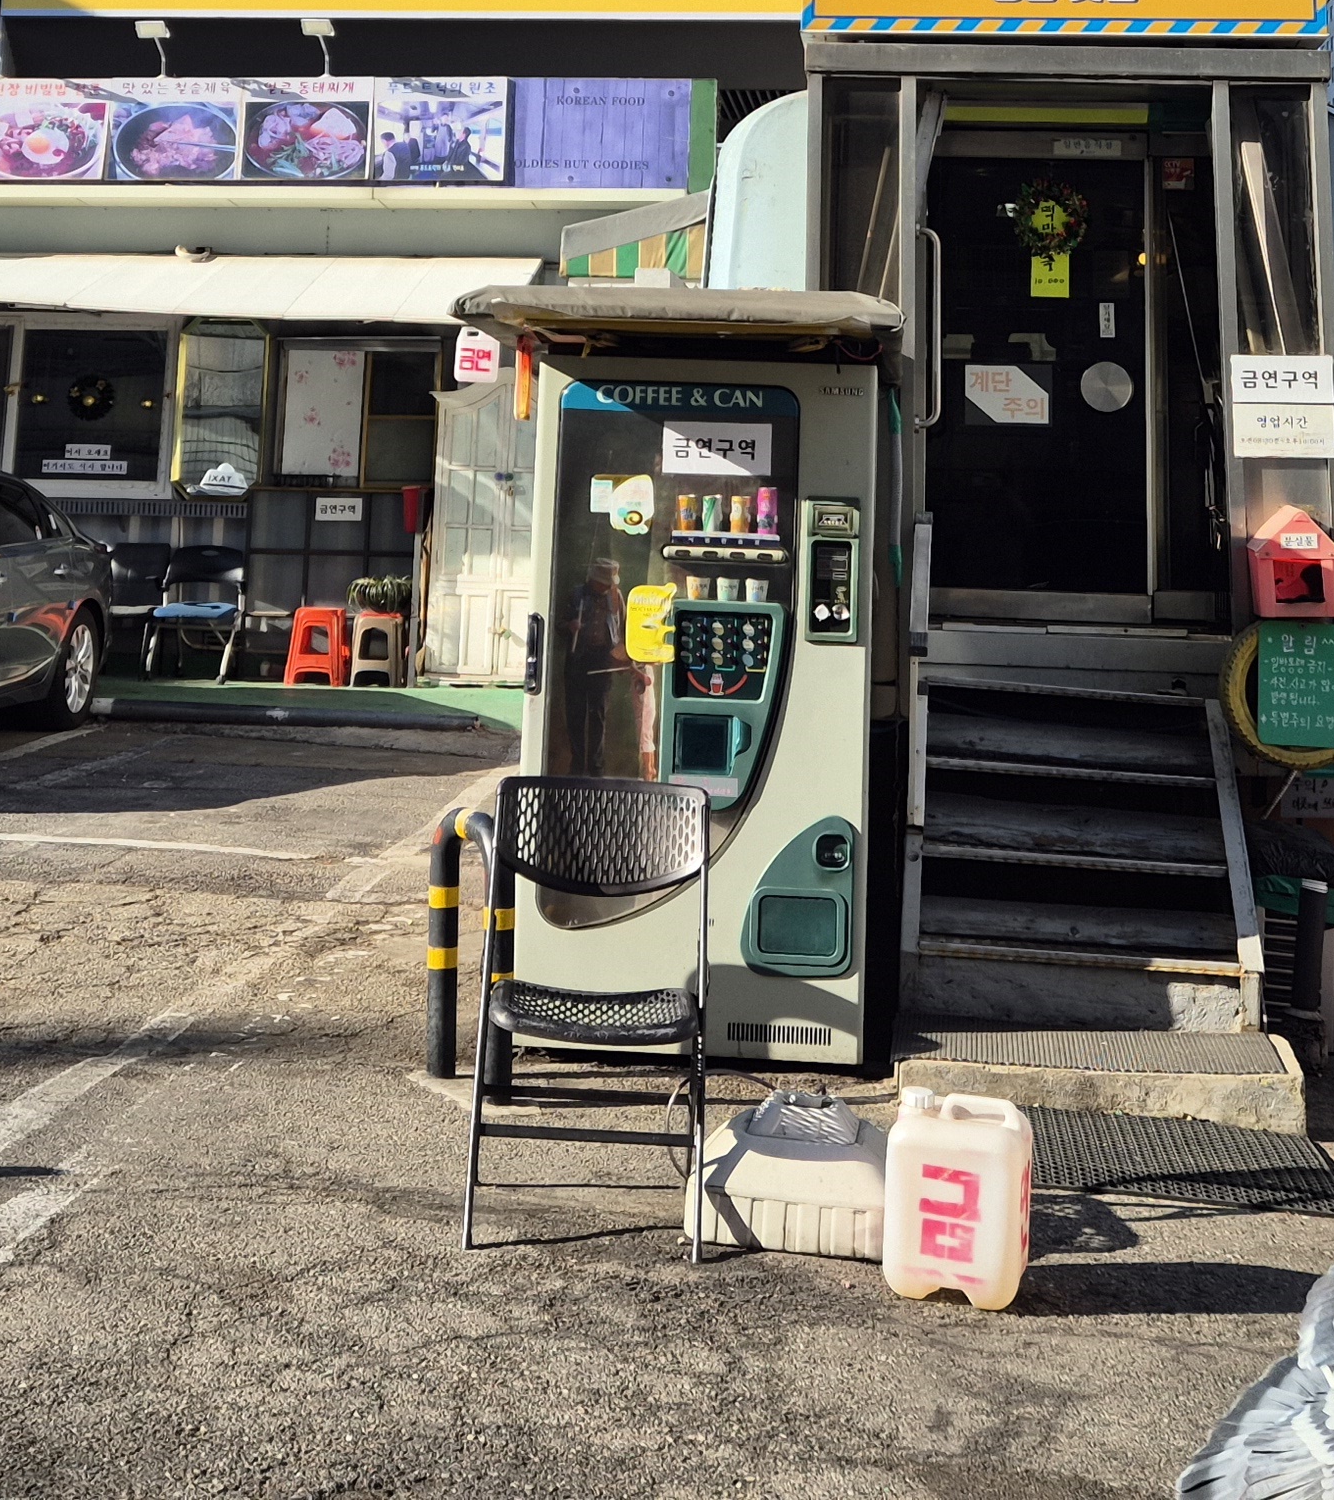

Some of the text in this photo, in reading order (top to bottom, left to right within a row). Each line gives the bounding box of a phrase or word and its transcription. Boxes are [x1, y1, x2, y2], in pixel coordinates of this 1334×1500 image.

[298, 81, 355, 95] 동태찌개
[469, 82, 496, 94] 원조
[557, 96, 645, 106] KOREAN FOOD
[514, 159, 649, 170] OLDIES BUT GOODIES
[457, 347, 492, 372] 금연
[970, 371, 1012, 392] 계단
[1240, 370, 1318, 389] 금연구역
[596, 385, 763, 408] COFFEE & CAN
[820, 386, 864, 396] SAMSUNG
[1002, 397, 1044, 419] 주의
[1257, 415, 1308, 429] 영업시간
[673, 438, 757, 460] 금연구역
[318, 503, 357, 516] 금연구역
[1284, 536, 1314, 546] 분실물
